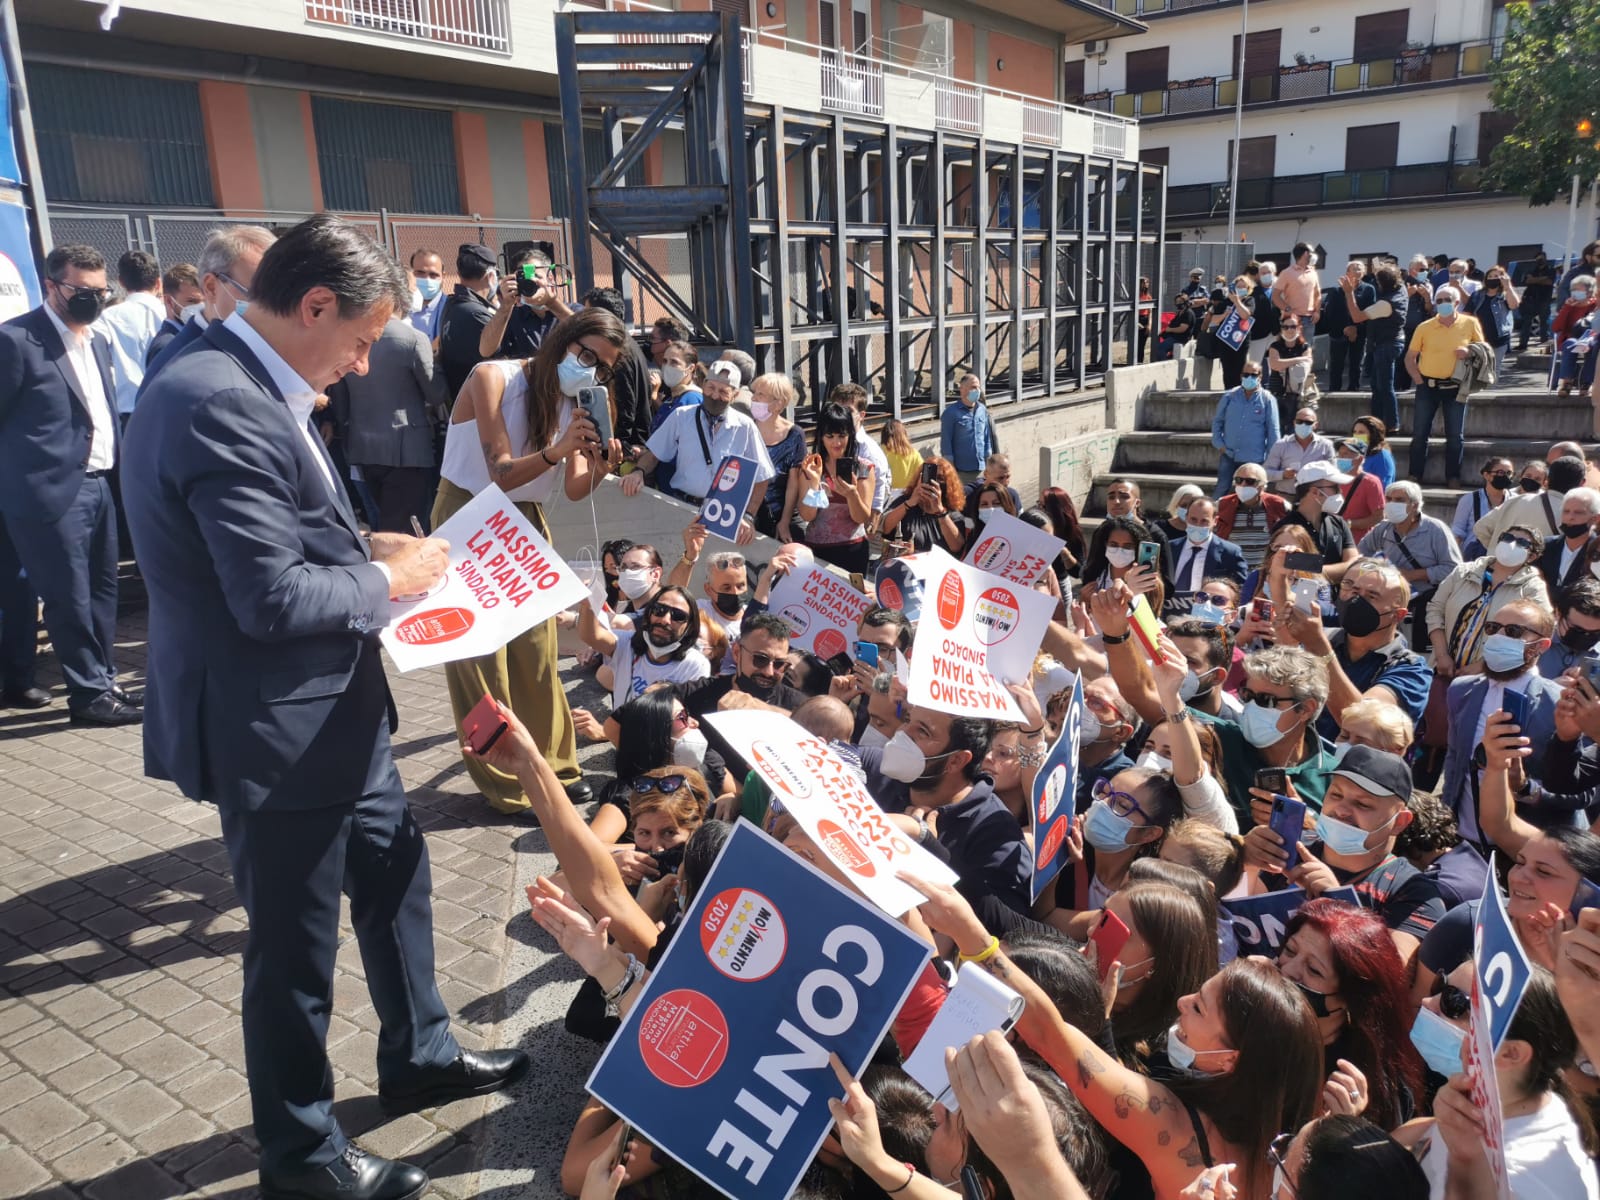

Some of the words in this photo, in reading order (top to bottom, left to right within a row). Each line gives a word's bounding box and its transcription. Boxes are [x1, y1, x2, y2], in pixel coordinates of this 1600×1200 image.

[1221, 310, 1240, 338] CONT
[704, 498, 736, 528] CO
[485, 509, 560, 590] MASSIMO
[1016, 554, 1036, 571] LA
[455, 559, 500, 609] SINDACO
[466, 529, 494, 561] LA
[484, 555, 533, 608] PIANA
[999, 560, 1017, 578] SIN
[802, 581, 819, 598] LA
[821, 592, 862, 625] PIANA
[804, 597, 848, 628] SINDACO
[991, 590, 1011, 604] 2050
[975, 613, 1011, 632] MOVIMENTO
[942, 638, 986, 666] SINDACO
[932, 655, 974, 685] PIANA
[978, 669, 999, 692] LA
[929, 679, 1008, 711] MASSIMO
[796, 741, 824, 768] LA
[830, 776, 894, 862] PIANA
[801, 757, 870, 847] SINDACO
[806, 738, 911, 855] MASSIMO
[704, 898, 729, 932] 2050
[730, 907, 772, 972] MOVIMENTO
[641, 998, 666, 1035] SINDACO
[662, 1001, 674, 1012] La
[645, 1015, 666, 1040] Piana
[650, 1005, 678, 1044] Massimo
[670, 1020, 697, 1060] attiva
[706, 924, 884, 1186] CONTE
